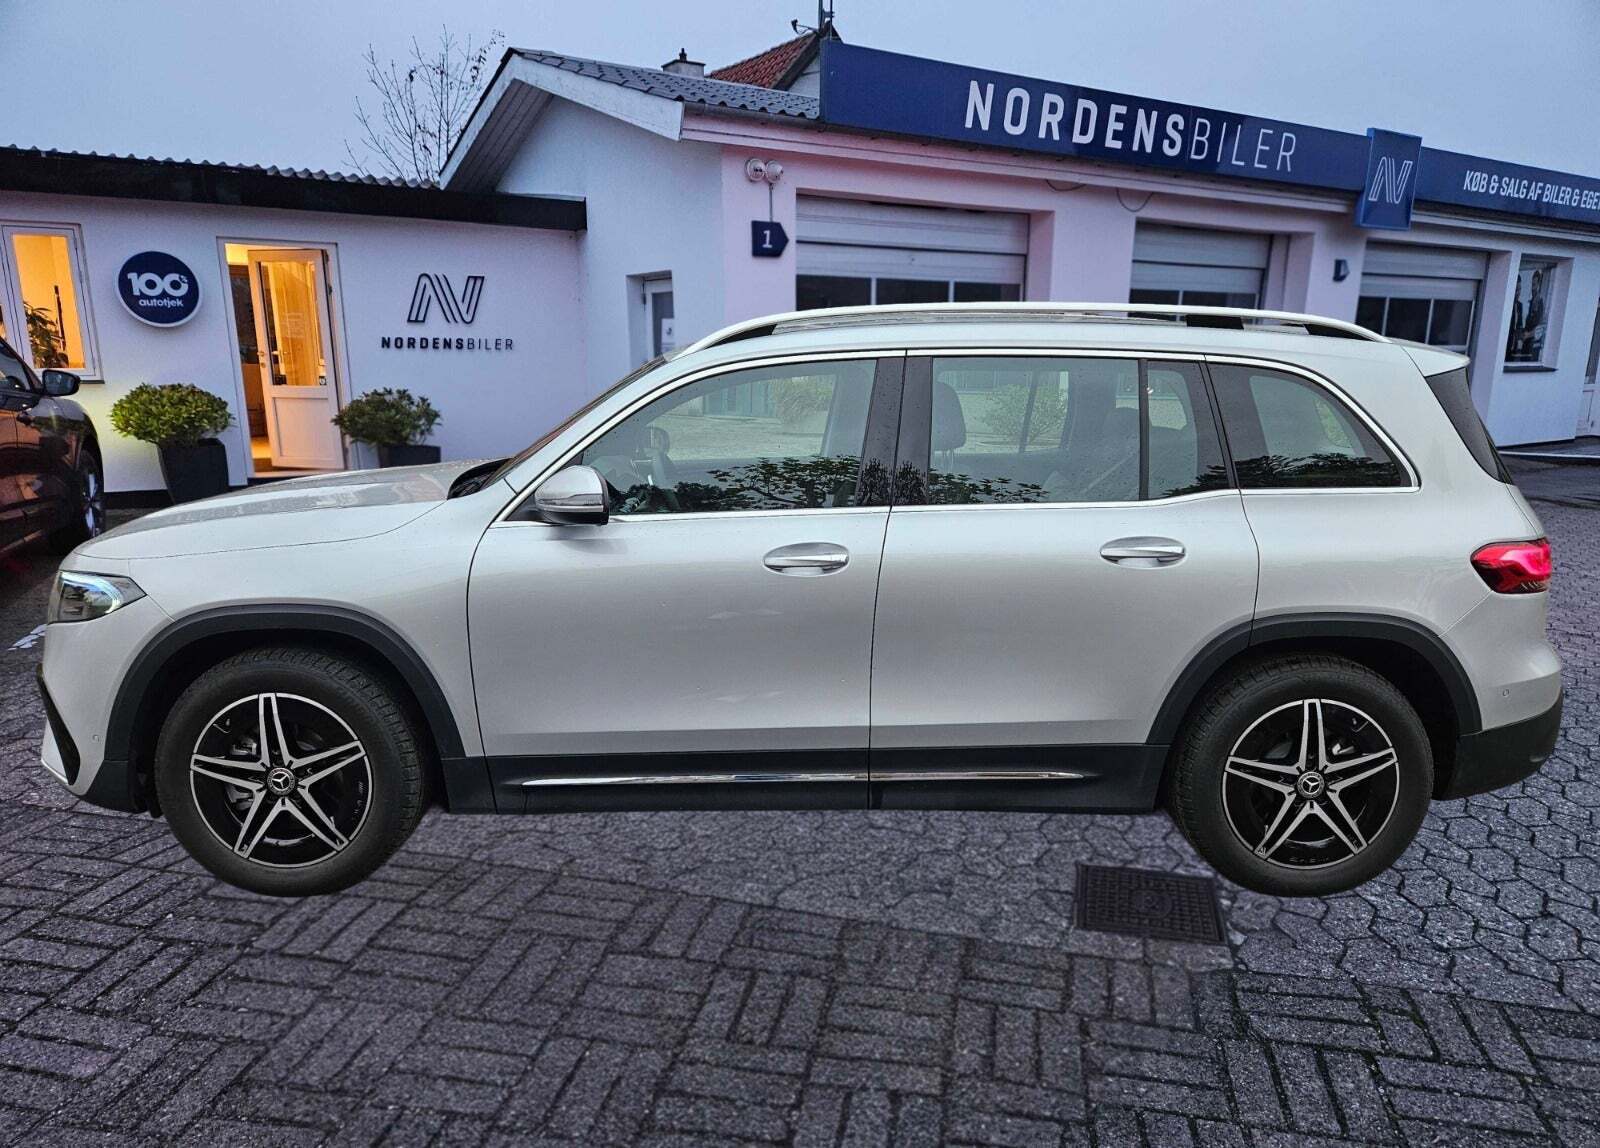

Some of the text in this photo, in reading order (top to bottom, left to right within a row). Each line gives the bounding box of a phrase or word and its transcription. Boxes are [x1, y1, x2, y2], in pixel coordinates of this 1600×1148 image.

[964, 80, 1297, 172] NORDENSBILER
[1463, 170, 1600, 210] KØB & SALG AF BILER & EGE
[762, 230, 773, 249] 1
[127, 272, 189, 297] 100
[138, 297, 184, 308] autotjek
[381, 337, 513, 350] NORDENSBILER
